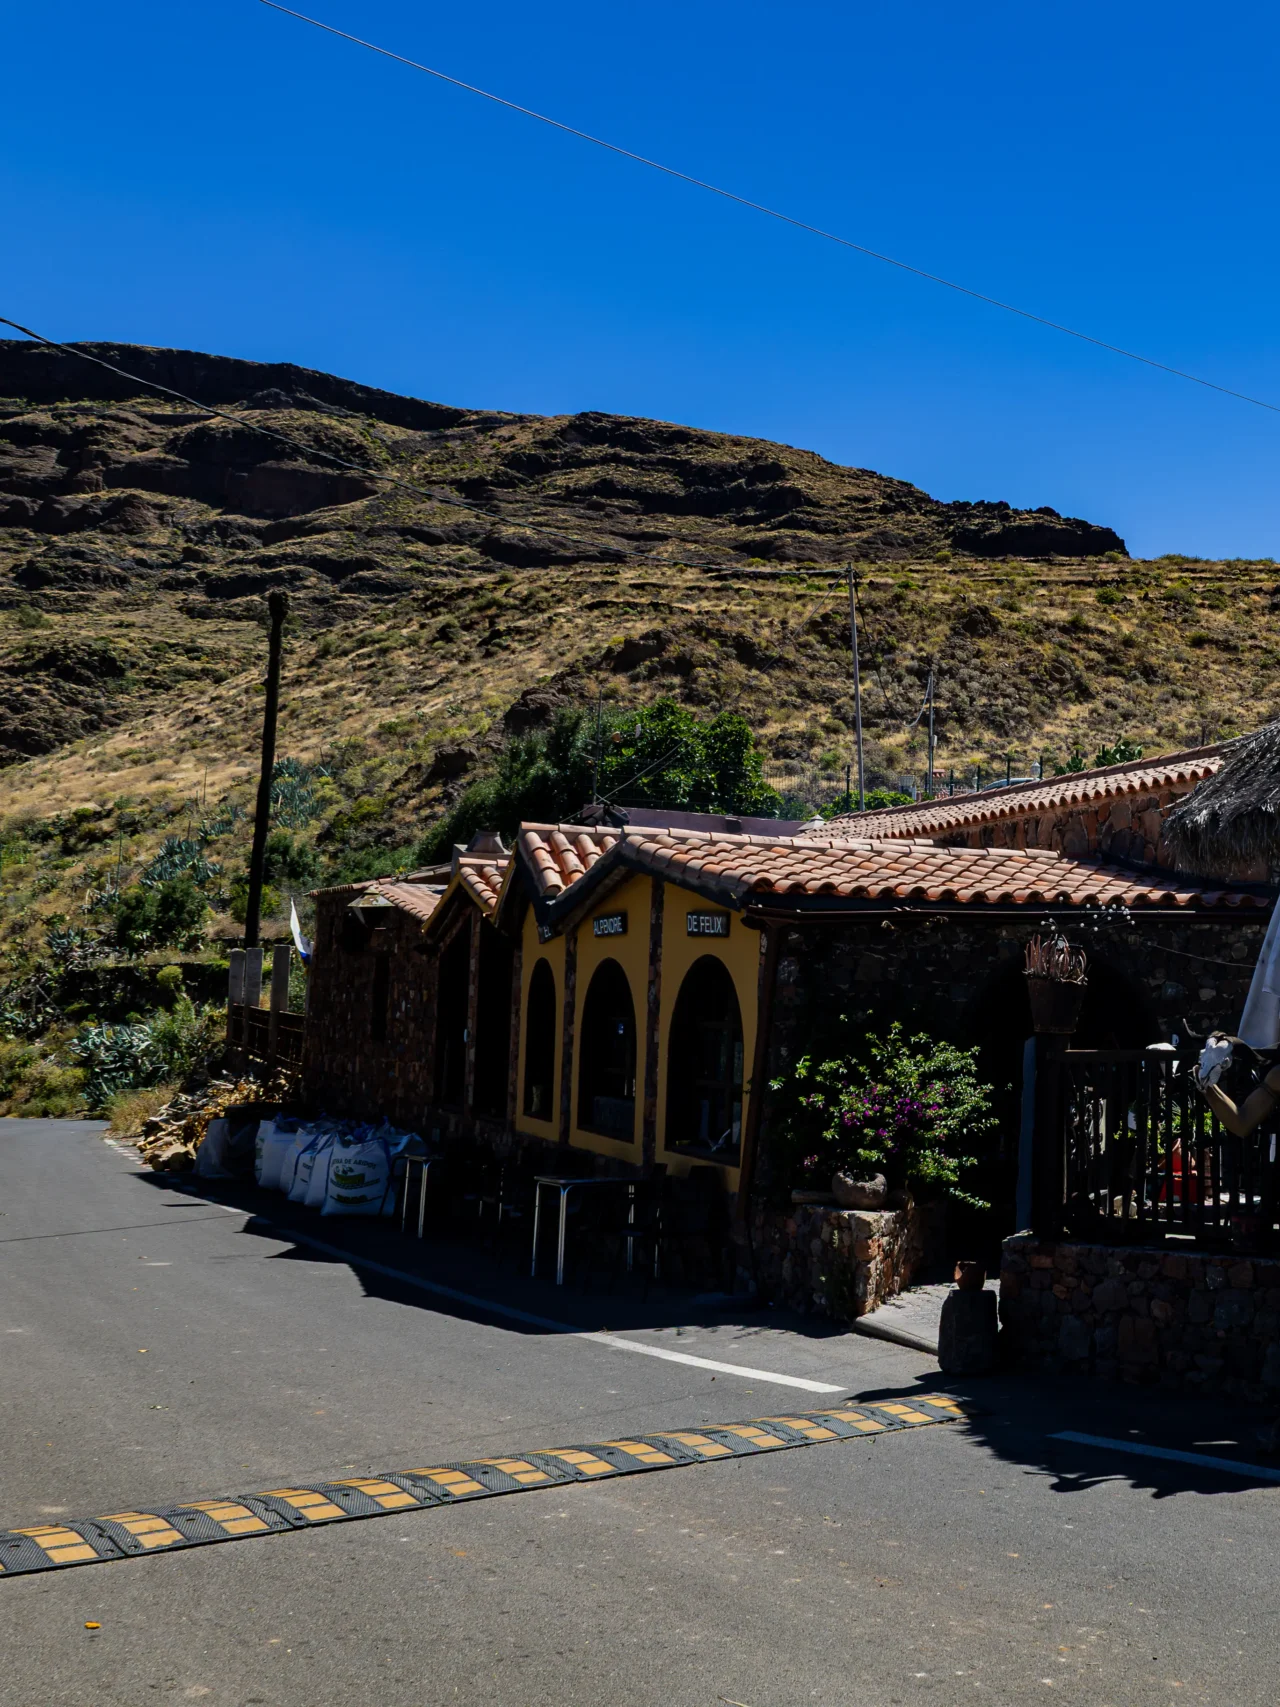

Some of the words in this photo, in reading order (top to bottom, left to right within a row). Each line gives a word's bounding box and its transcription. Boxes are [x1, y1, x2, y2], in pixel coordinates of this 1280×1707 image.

[593, 916, 623, 935] ALPENDRE
[687, 915, 698, 932] DE
[699, 916, 723, 934] FELIX
